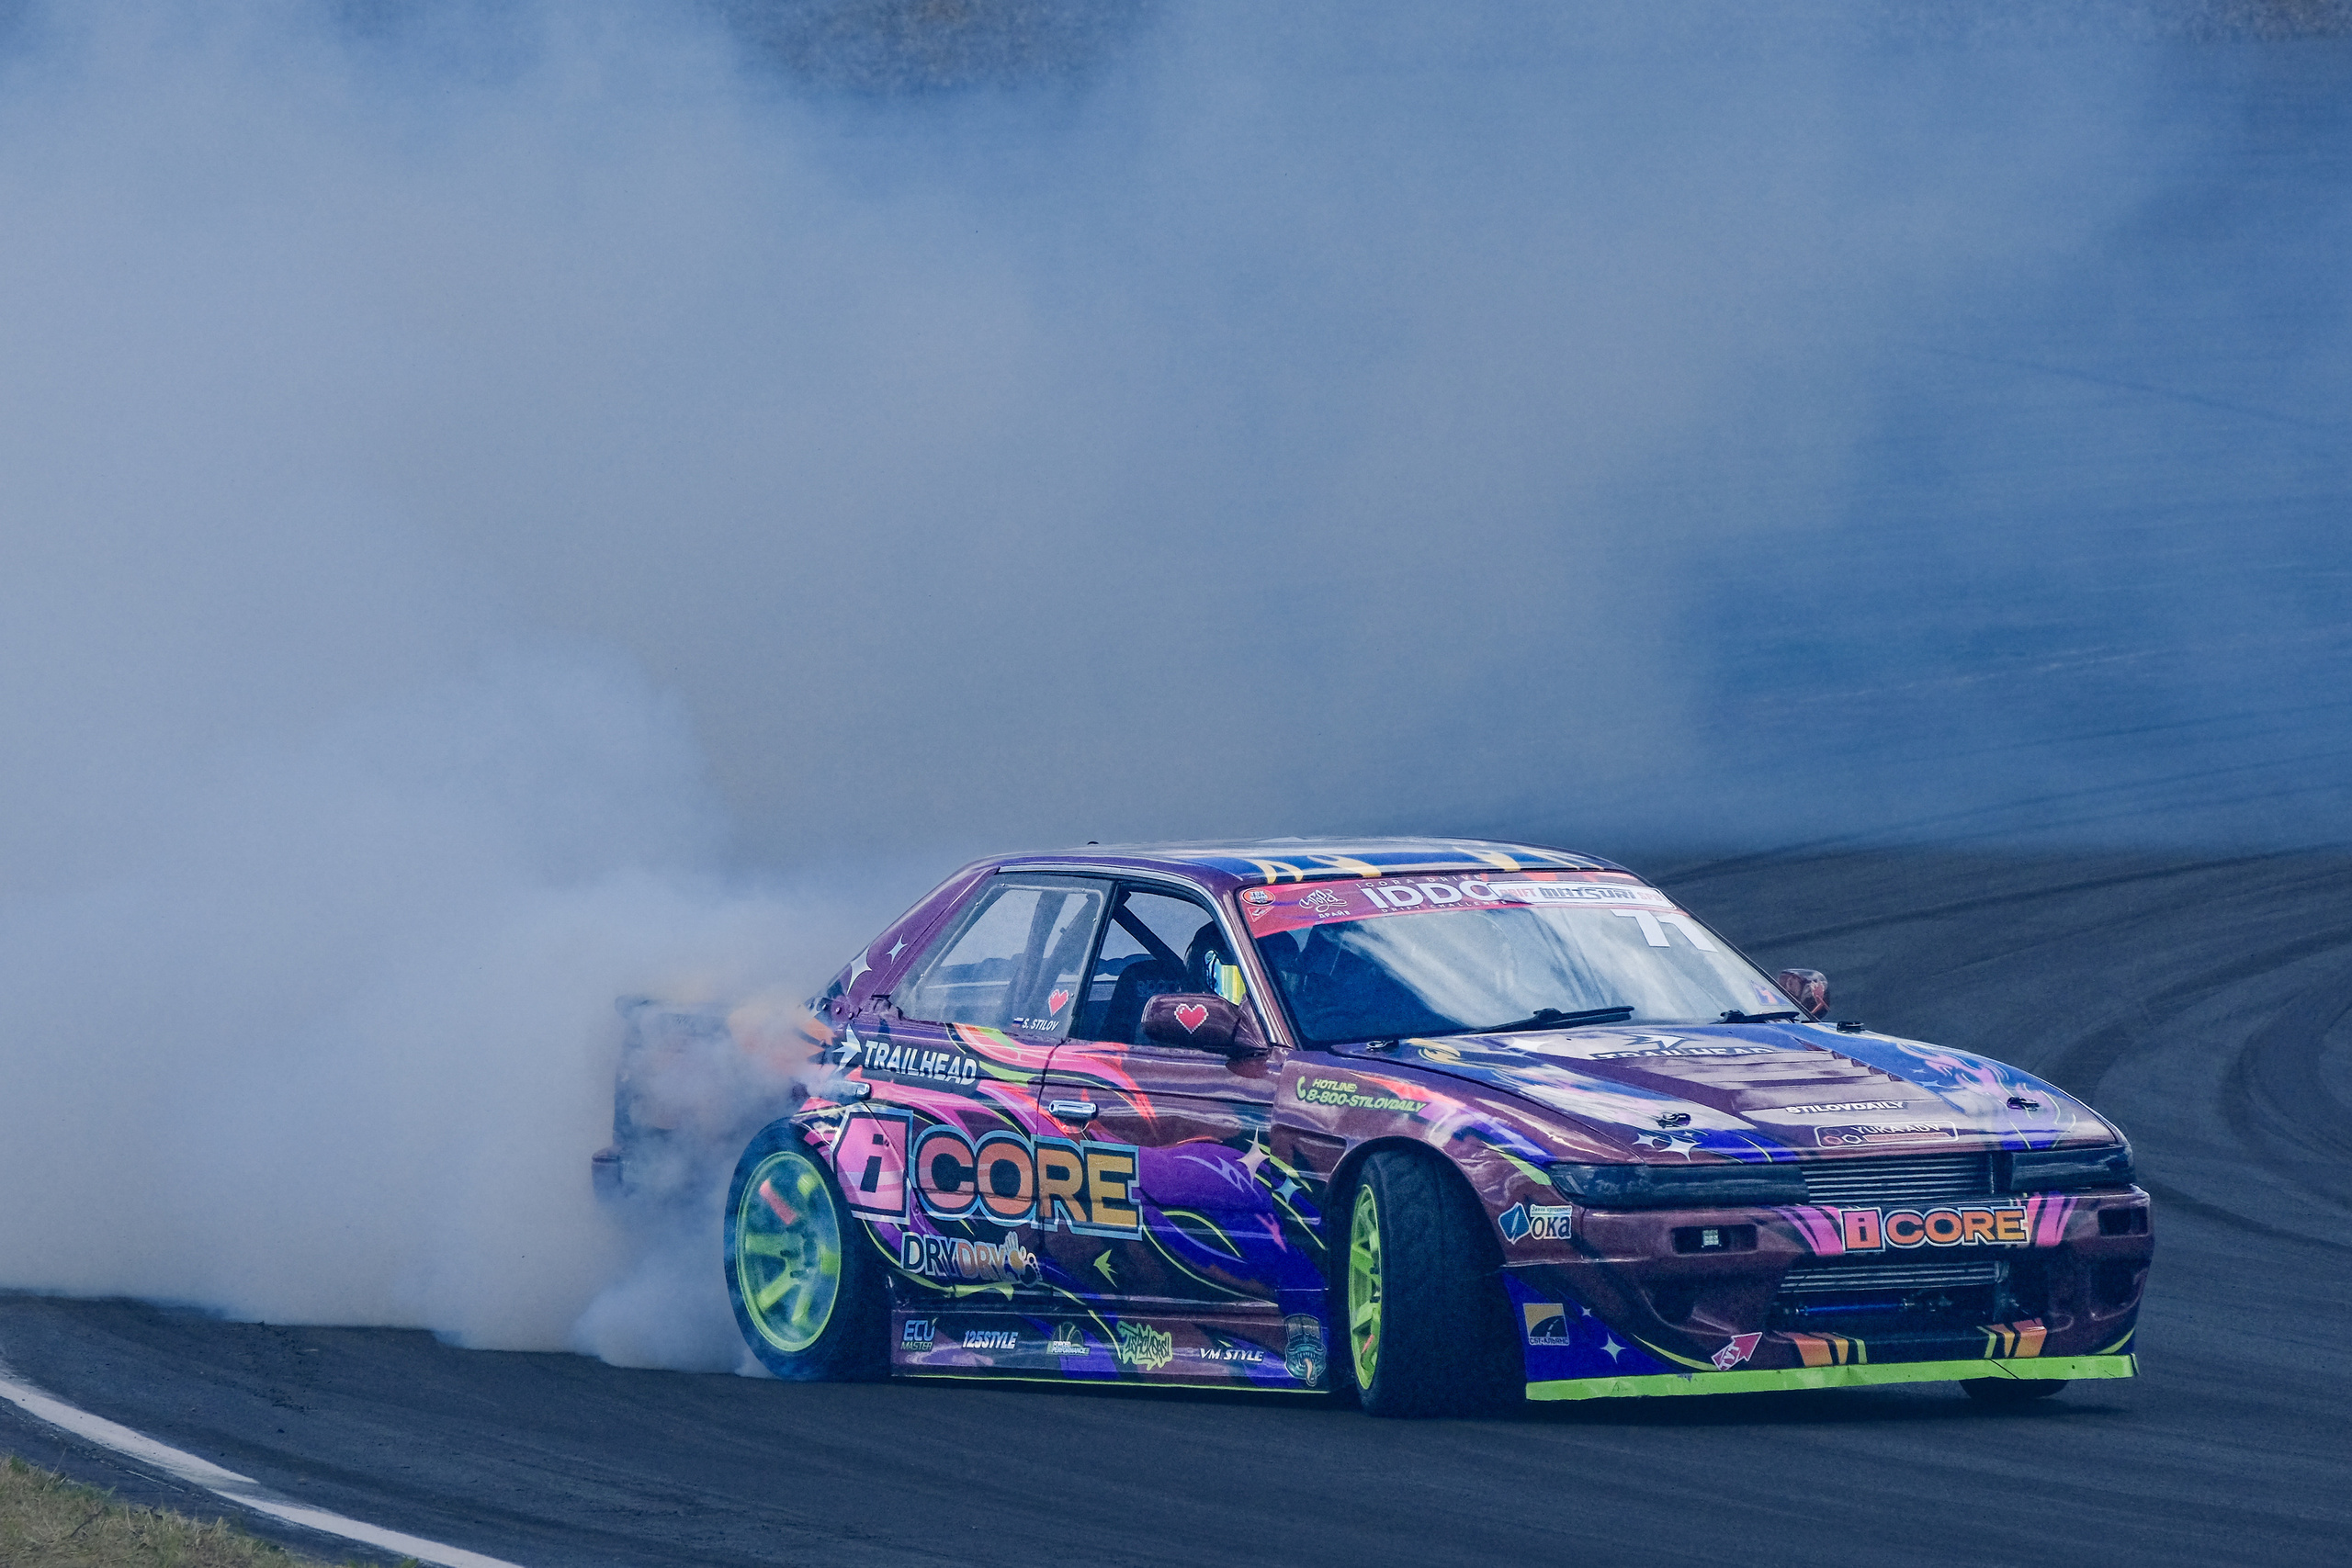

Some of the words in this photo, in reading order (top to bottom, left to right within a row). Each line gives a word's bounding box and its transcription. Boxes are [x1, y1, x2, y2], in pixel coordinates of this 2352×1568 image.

[1022, 1018, 1030, 1029] S.
[1030, 1019, 1059, 1032] STILOV
[865, 1040, 977, 1085] TRAILHEAD
[1312, 1078, 1358, 1093] HOTLINE:
[1306, 1089, 1427, 1113] 8-800-STILOVDAILY
[1787, 1101, 1905, 1114] STILOVDAILY
[1851, 1124, 1905, 1134] YUKA
[903, 1319, 936, 1341] ECU
[901, 1341, 933, 1351] MASTER
[962, 1330, 1018, 1349] 125STYLE
[1200, 1348, 1221, 1359] VM
[1223, 1349, 1264, 1361] STYLE
